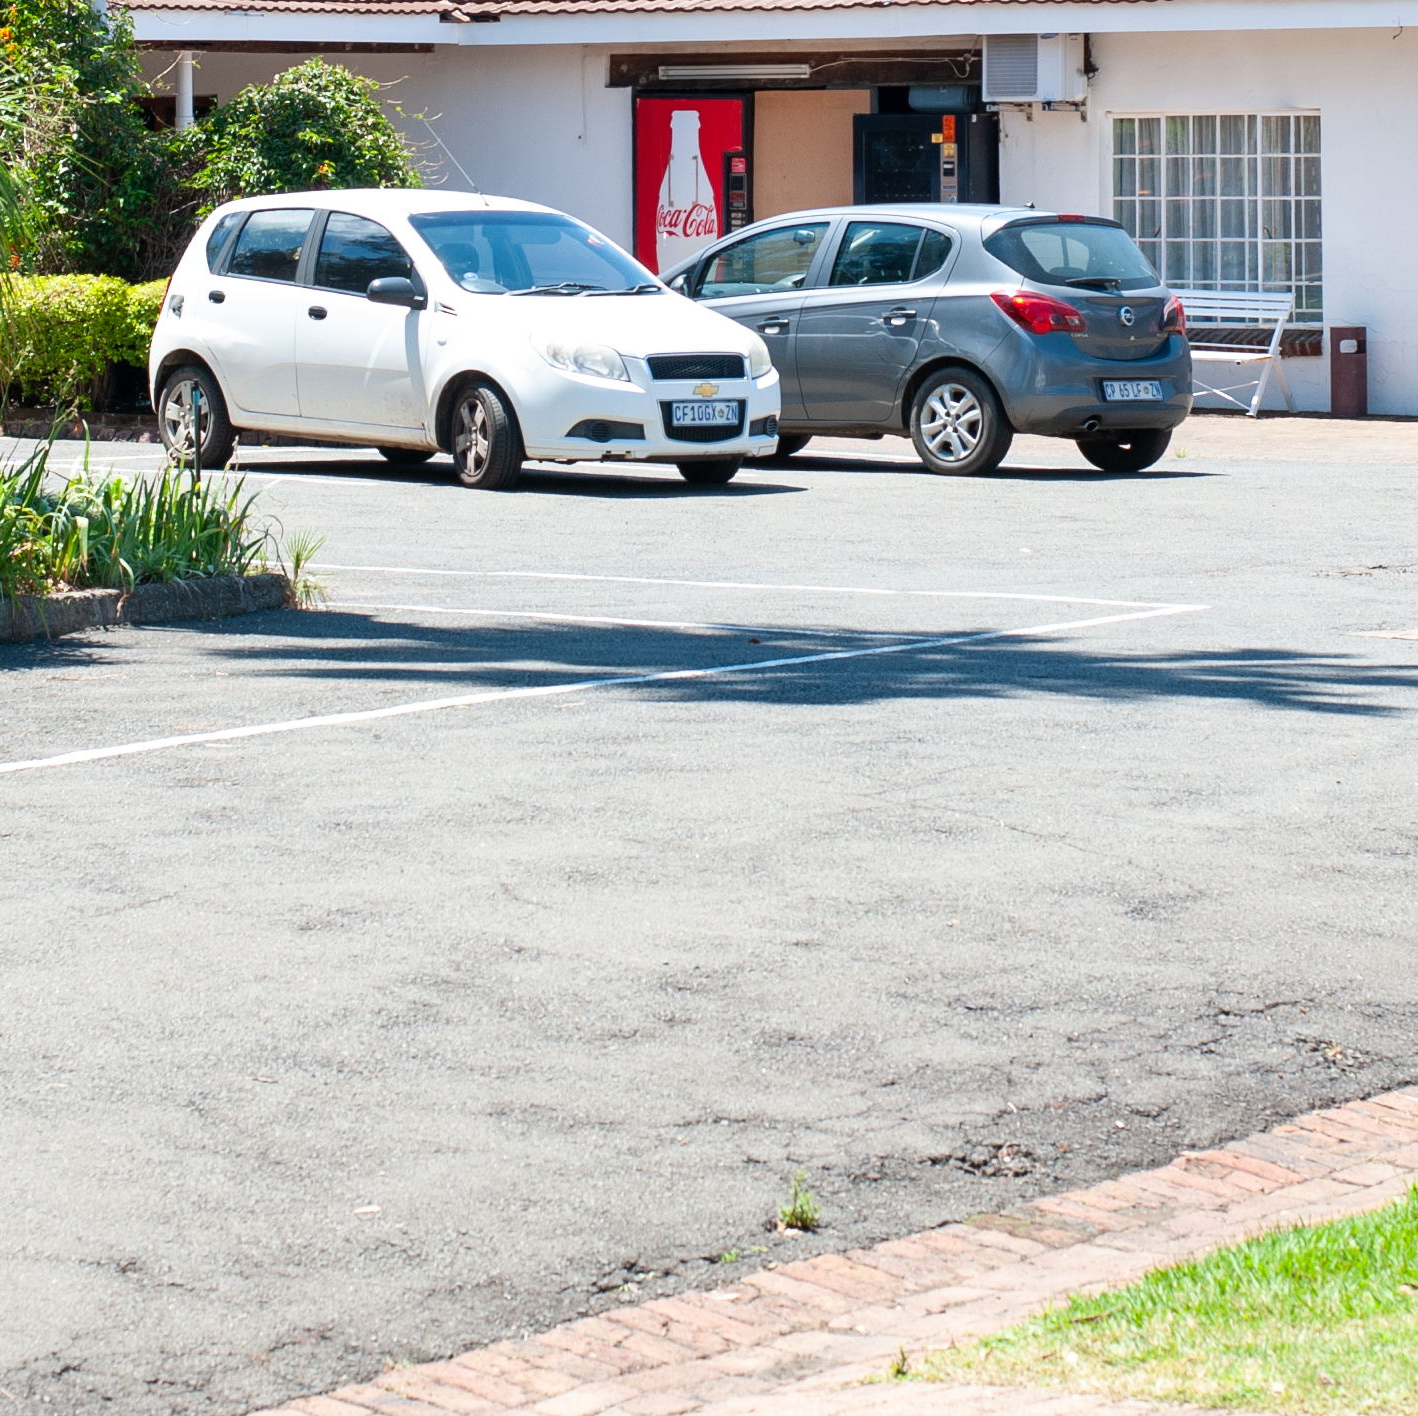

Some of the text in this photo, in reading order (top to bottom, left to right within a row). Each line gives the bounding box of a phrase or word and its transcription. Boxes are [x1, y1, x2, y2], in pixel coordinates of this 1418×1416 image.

[657, 203, 717, 238] Coca-Cola
[1148, 383, 1162, 398] ZN
[725, 404, 738, 422] ZN
